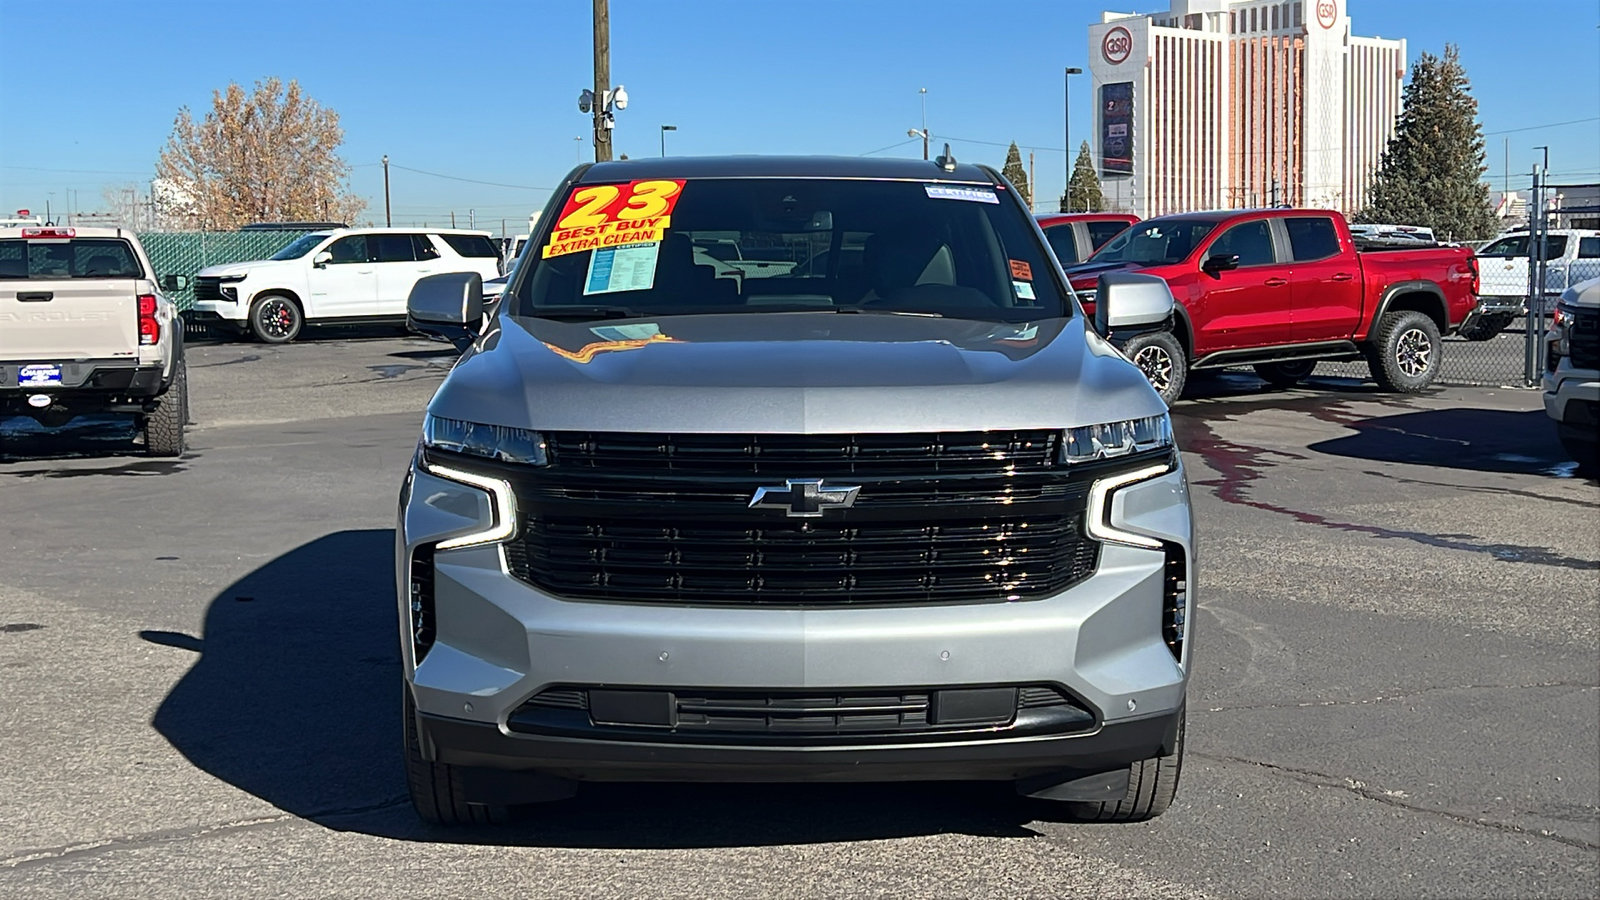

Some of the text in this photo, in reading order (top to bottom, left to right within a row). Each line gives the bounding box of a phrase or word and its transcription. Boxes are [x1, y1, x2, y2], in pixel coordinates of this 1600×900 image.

[1319, 3, 1334, 19] GSR
[1107, 37, 1128, 54] GSR
[559, 180, 681, 229] 23
[556, 218, 661, 242] BEST BUY
[549, 230, 655, 256] EXTRA CLEAN
